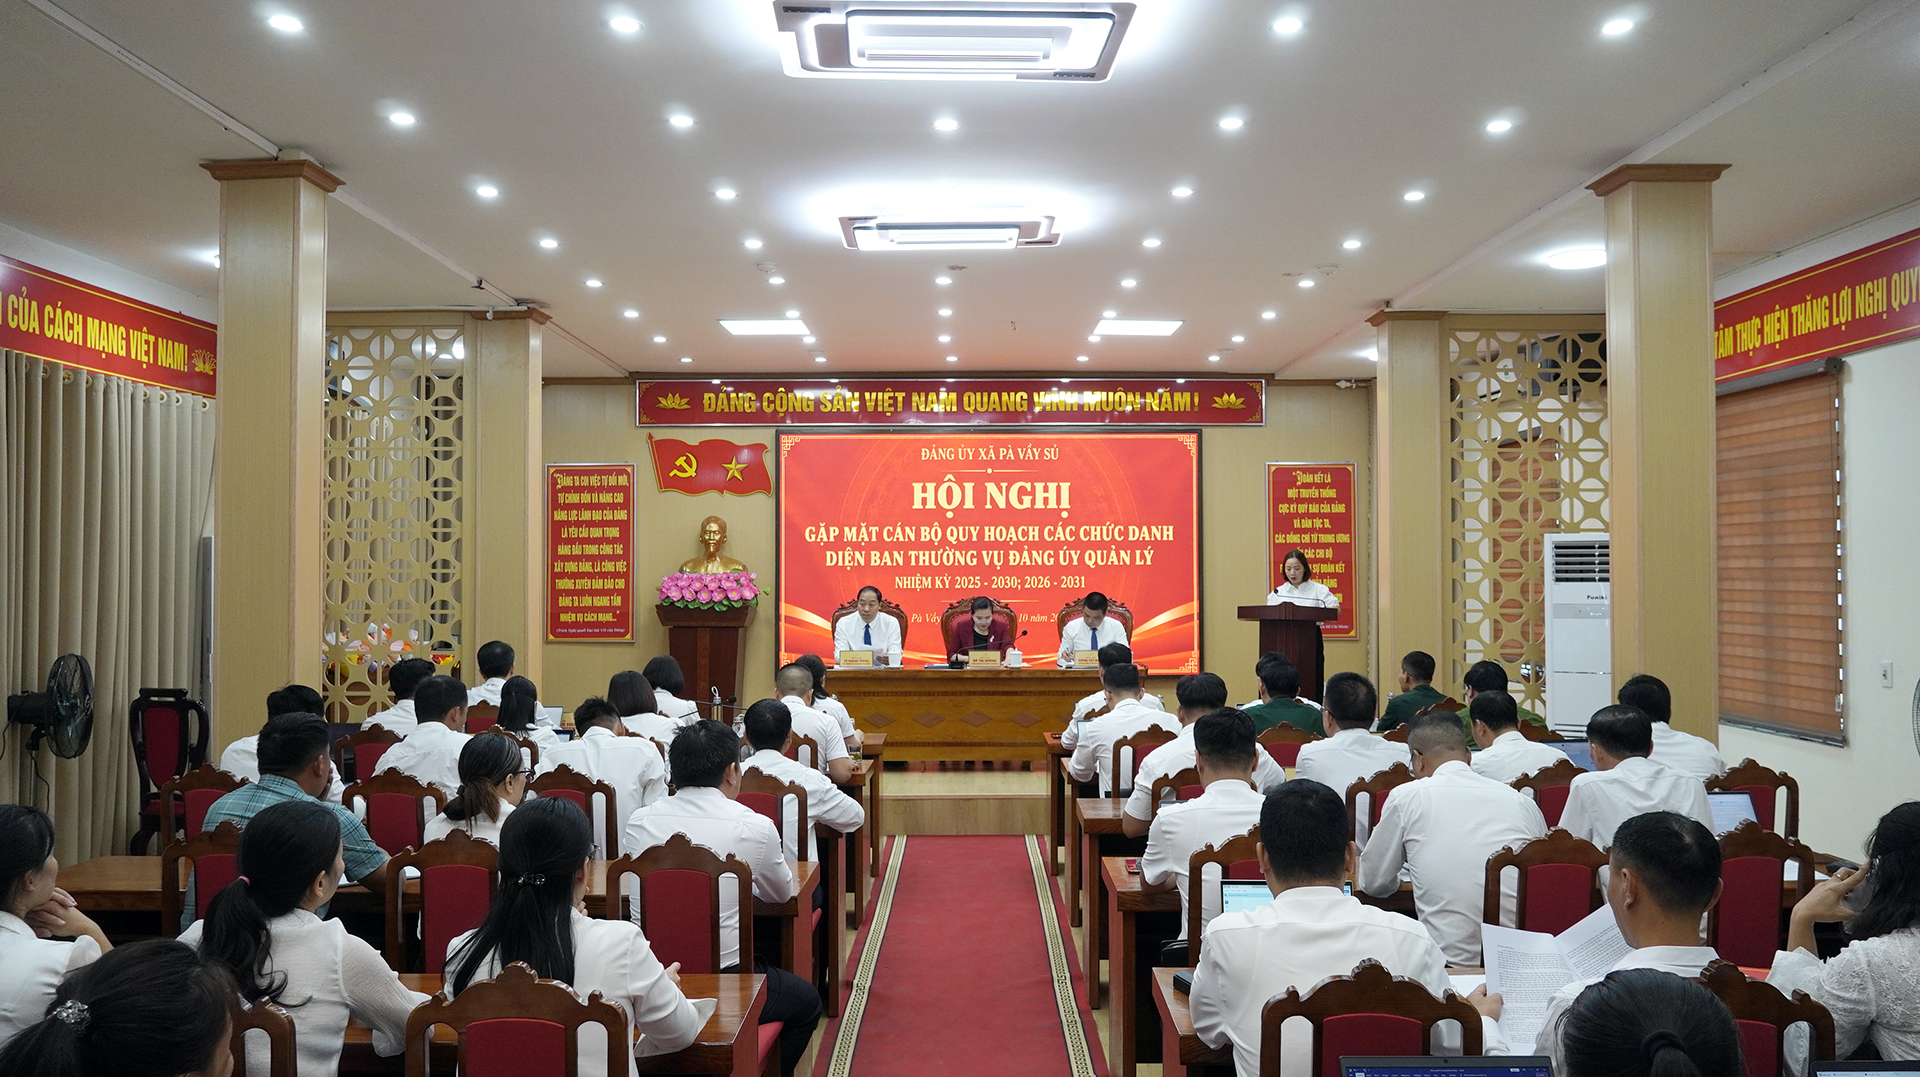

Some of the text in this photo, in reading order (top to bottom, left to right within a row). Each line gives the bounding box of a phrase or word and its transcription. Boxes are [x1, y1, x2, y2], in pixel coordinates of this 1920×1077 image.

[1735, 315, 1761, 356] THỰC
[1764, 304, 1789, 349] HIỆN
[1833, 285, 1852, 331] LỢI
[1855, 277, 1887, 320] NGHỊ
[1891, 266, 1920, 312] QUY
[8, 286, 39, 335] CỦA
[44, 301, 83, 346] CÁCH
[87, 317, 126, 359] MẠNG
[129, 327, 155, 369] VIỆT
[158, 337, 188, 372] NAM!
[703, 386, 756, 413] ĐẢNG
[762, 387, 814, 417] CỘNG
[819, 385, 860, 413] SẢN
[864, 387, 905, 416] VIỆT
[912, 391, 957, 412] NAM
[962, 391, 1028, 414] QUANG
[1033, 391, 1079, 412] VINH
[1083, 387, 1140, 412] MUÔN
[921, 444, 955, 460] ĐẢNG
[958, 444, 975, 460] ỦY
[978, 445, 996, 460] XÃ
[999, 444, 1015, 460] PÀ
[1043, 444, 1059, 460] SỦ
[574, 475, 580, 486] TA
[590, 474, 601, 488] VIỆC
[1314, 471, 1323, 483] KẾT
[1324, 472, 1331, 483] LÀ
[592, 491, 598, 503] VÀ
[614, 492, 624, 503] CAO
[912, 474, 1071, 519] HỘI NGHỊ
[1288, 487, 1298, 500] MỘT
[592, 509, 602, 523] ĐẠO
[603, 507, 613, 520] CỦA
[614, 507, 627, 520] ĐẢNG
[1279, 502, 1289, 515] CỰC
[1320, 501, 1330, 513] CỦA
[1331, 501, 1345, 513] ĐẢNG
[1293, 517, 1300, 528] VÀ
[1301, 517, 1312, 528] DÂN
[1313, 517, 1323, 530] TỘC
[561, 525, 568, 538] LÀ
[568, 525, 578, 538] YÊU
[590, 527, 603, 539] QUAN
[604, 527, 620, 540] TRỌNG
[804, 521, 1175, 546] GẶP MẶT CÁN BỘ QUY HOẠCH CÁC CHỨC DANH
[1275, 532, 1285, 543] CÁC
[1301, 532, 1310, 543] CHÍ
[1319, 534, 1335, 543] TRUNG
[583, 545, 599, 555] TRONG
[600, 543, 613, 555] CÔNG
[614, 543, 623, 555] TÁC
[1305, 547, 1315, 558] CÁC
[1316, 549, 1325, 558] CHI
[1326, 547, 1333, 560] BỘ
[825, 546, 866, 571] DIỆN
[870, 550, 904, 566] BAN
[908, 546, 978, 566] THƯỜNG
[981, 550, 1004, 570] VỤ
[1008, 545, 1055, 566] ĐẢNG
[1084, 545, 1131, 568] QUẢN
[1135, 545, 1155, 566] LÝ
[554, 560, 563, 572] XÂY
[564, 561, 578, 574] DỰNG
[594, 560, 601, 572] LÀ
[602, 560, 615, 572] CÔNG
[616, 560, 627, 574] VIỆC
[1313, 562, 1320, 575] SỰ
[1321, 562, 1334, 573] ĐOÀN
[1336, 561, 1345, 573] KẾT
[615, 578, 625, 589] CHO
[895, 573, 932, 592] NHIỆM
[935, 573, 952, 589] KỲ
[954, 576, 981, 589] 2025
[991, 576, 1022, 590] 2030;
[1024, 576, 1051, 589] 2026
[1060, 575, 1085, 589] 2031
[558, 593, 572, 607] ĐẢNG
[573, 596, 578, 606] TA
[580, 594, 592, 606] LUÔN
[593, 596, 610, 606] NGANG
[560, 611, 576, 623] NHIỆM
[577, 612, 583, 623] VỤ
[584, 611, 597, 622] CÁCH
[911, 613, 922, 623] Pà
[1018, 613, 1059, 623] 10 năm 20
